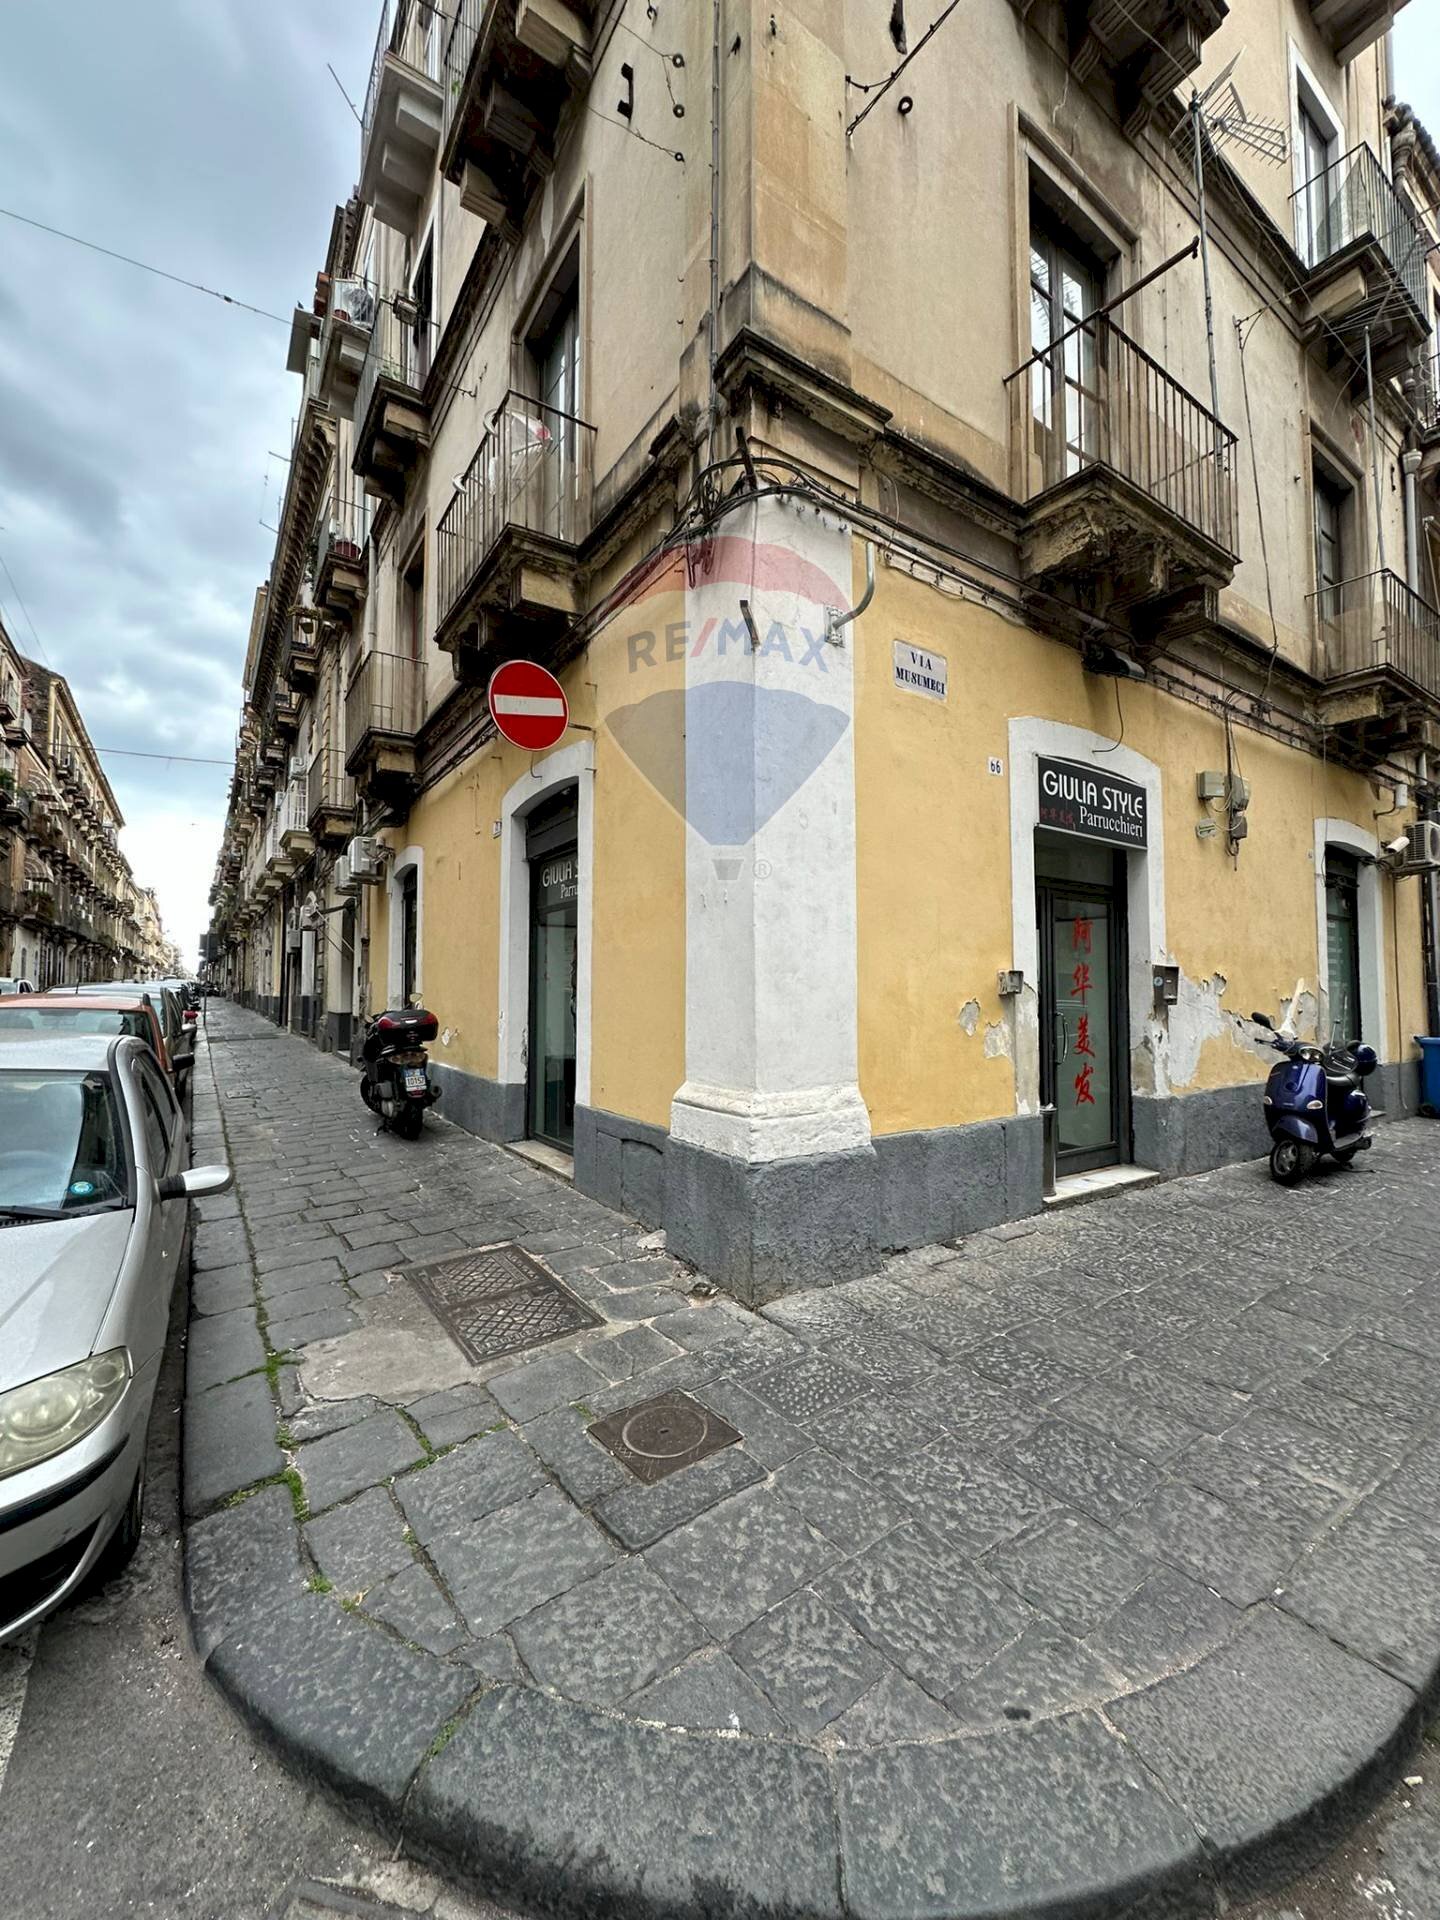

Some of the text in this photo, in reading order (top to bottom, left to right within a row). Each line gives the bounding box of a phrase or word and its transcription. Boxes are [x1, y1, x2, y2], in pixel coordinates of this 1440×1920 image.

[911, 651, 932, 670] VIA
[896, 666, 945, 694] MUSUMECI
[990, 758, 1001, 774] 66
[1043, 770, 1097, 807] GIULIA
[1102, 787, 1144, 819] STYLE
[1079, 805, 1143, 838] Parrucchieri
[542, 861, 572, 887] GIULIA
